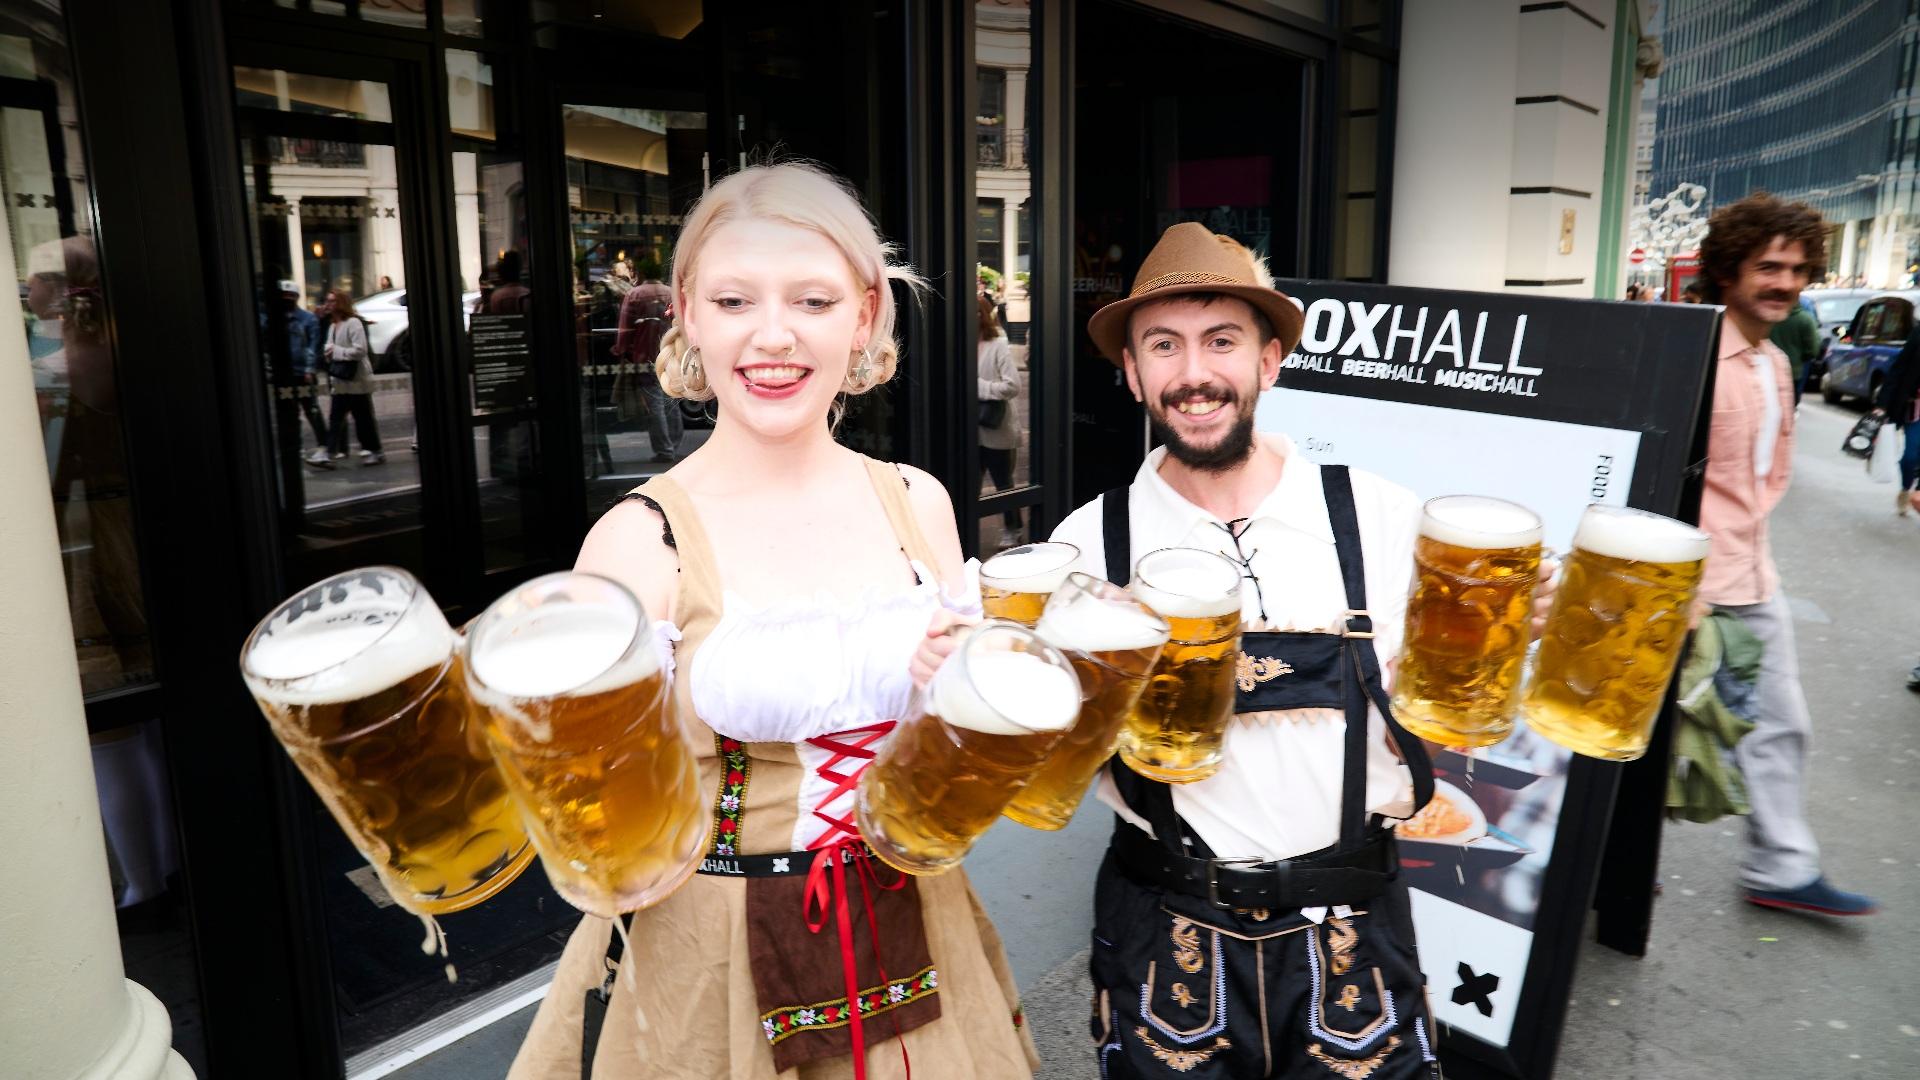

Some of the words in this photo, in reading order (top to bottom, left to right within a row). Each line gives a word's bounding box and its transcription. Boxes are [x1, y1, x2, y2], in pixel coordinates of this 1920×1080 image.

[1288, 296, 1544, 377] OXHALL
[1340, 358, 1427, 384] BEERHALL
[1433, 368, 1539, 397] MUSICHALL
